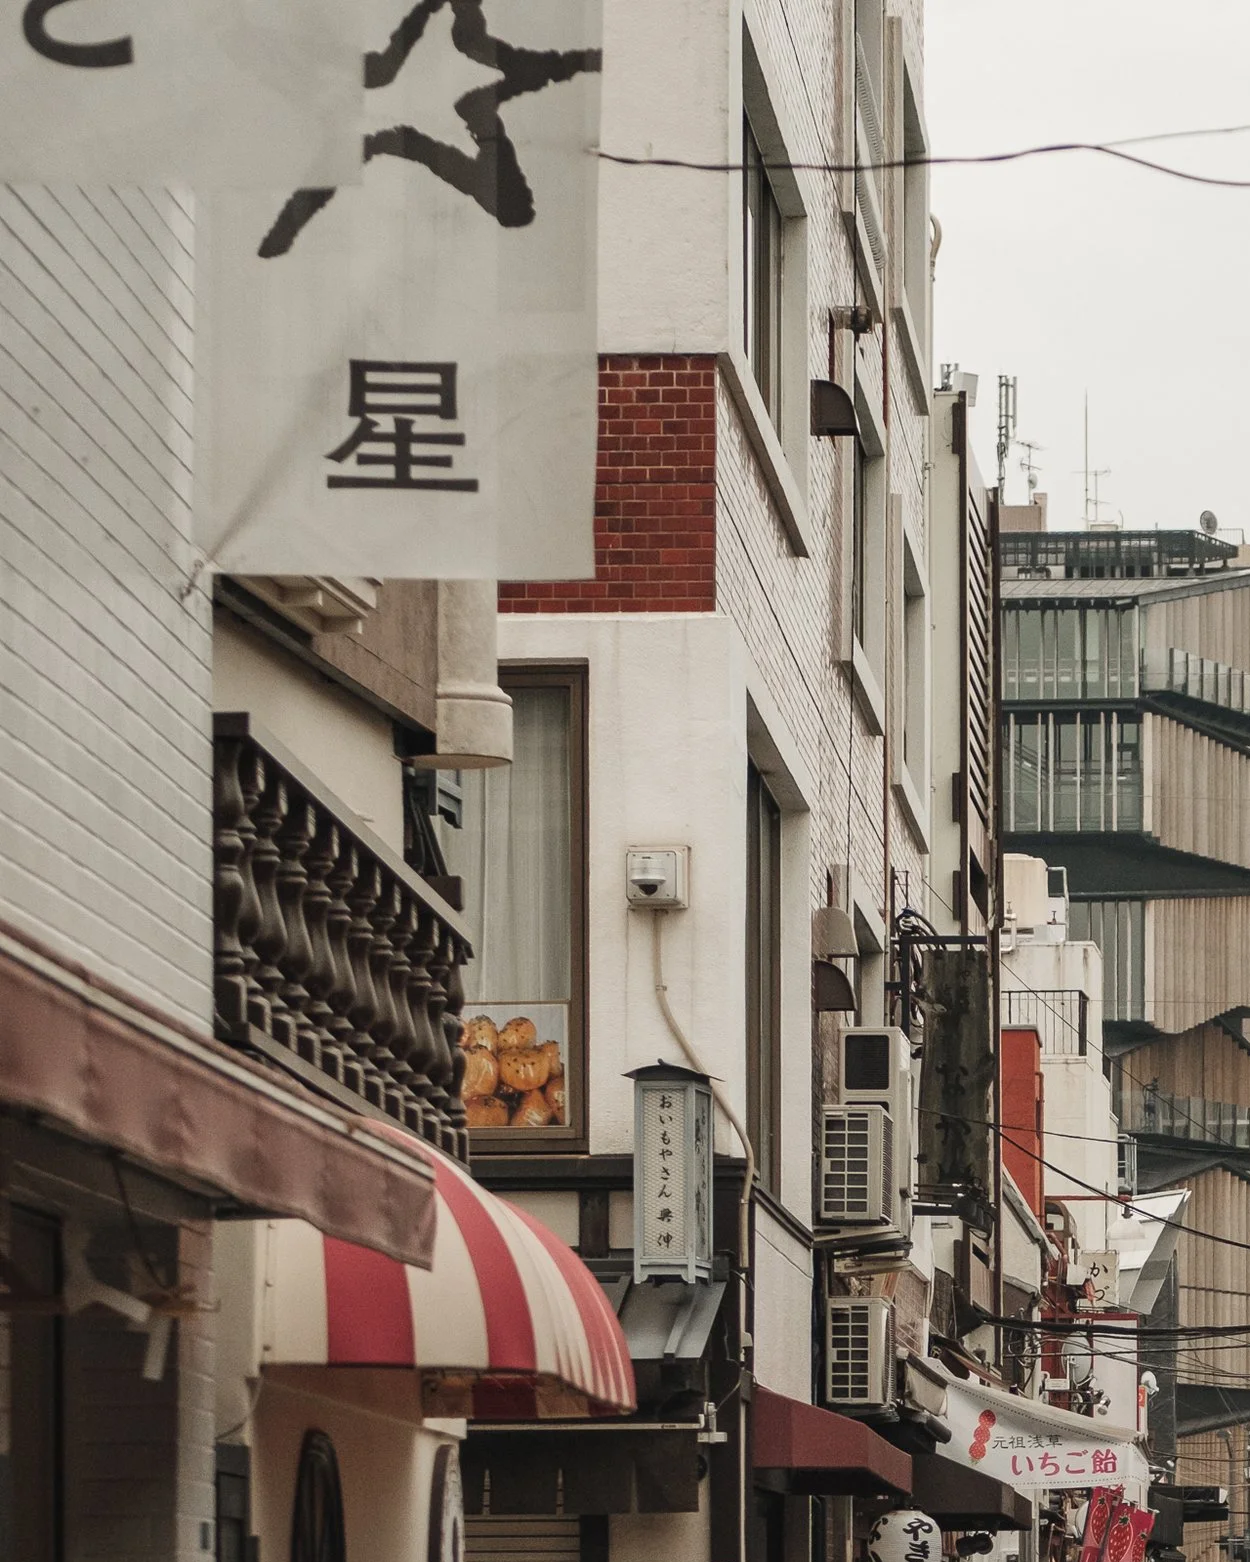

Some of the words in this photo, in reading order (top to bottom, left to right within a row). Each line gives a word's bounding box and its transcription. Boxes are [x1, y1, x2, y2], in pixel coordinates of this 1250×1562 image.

[326, 358, 480, 494] 星
[992, 1434, 1063, 1450] 元祖浅草
[1011, 1448, 1118, 1477] いちご飴
